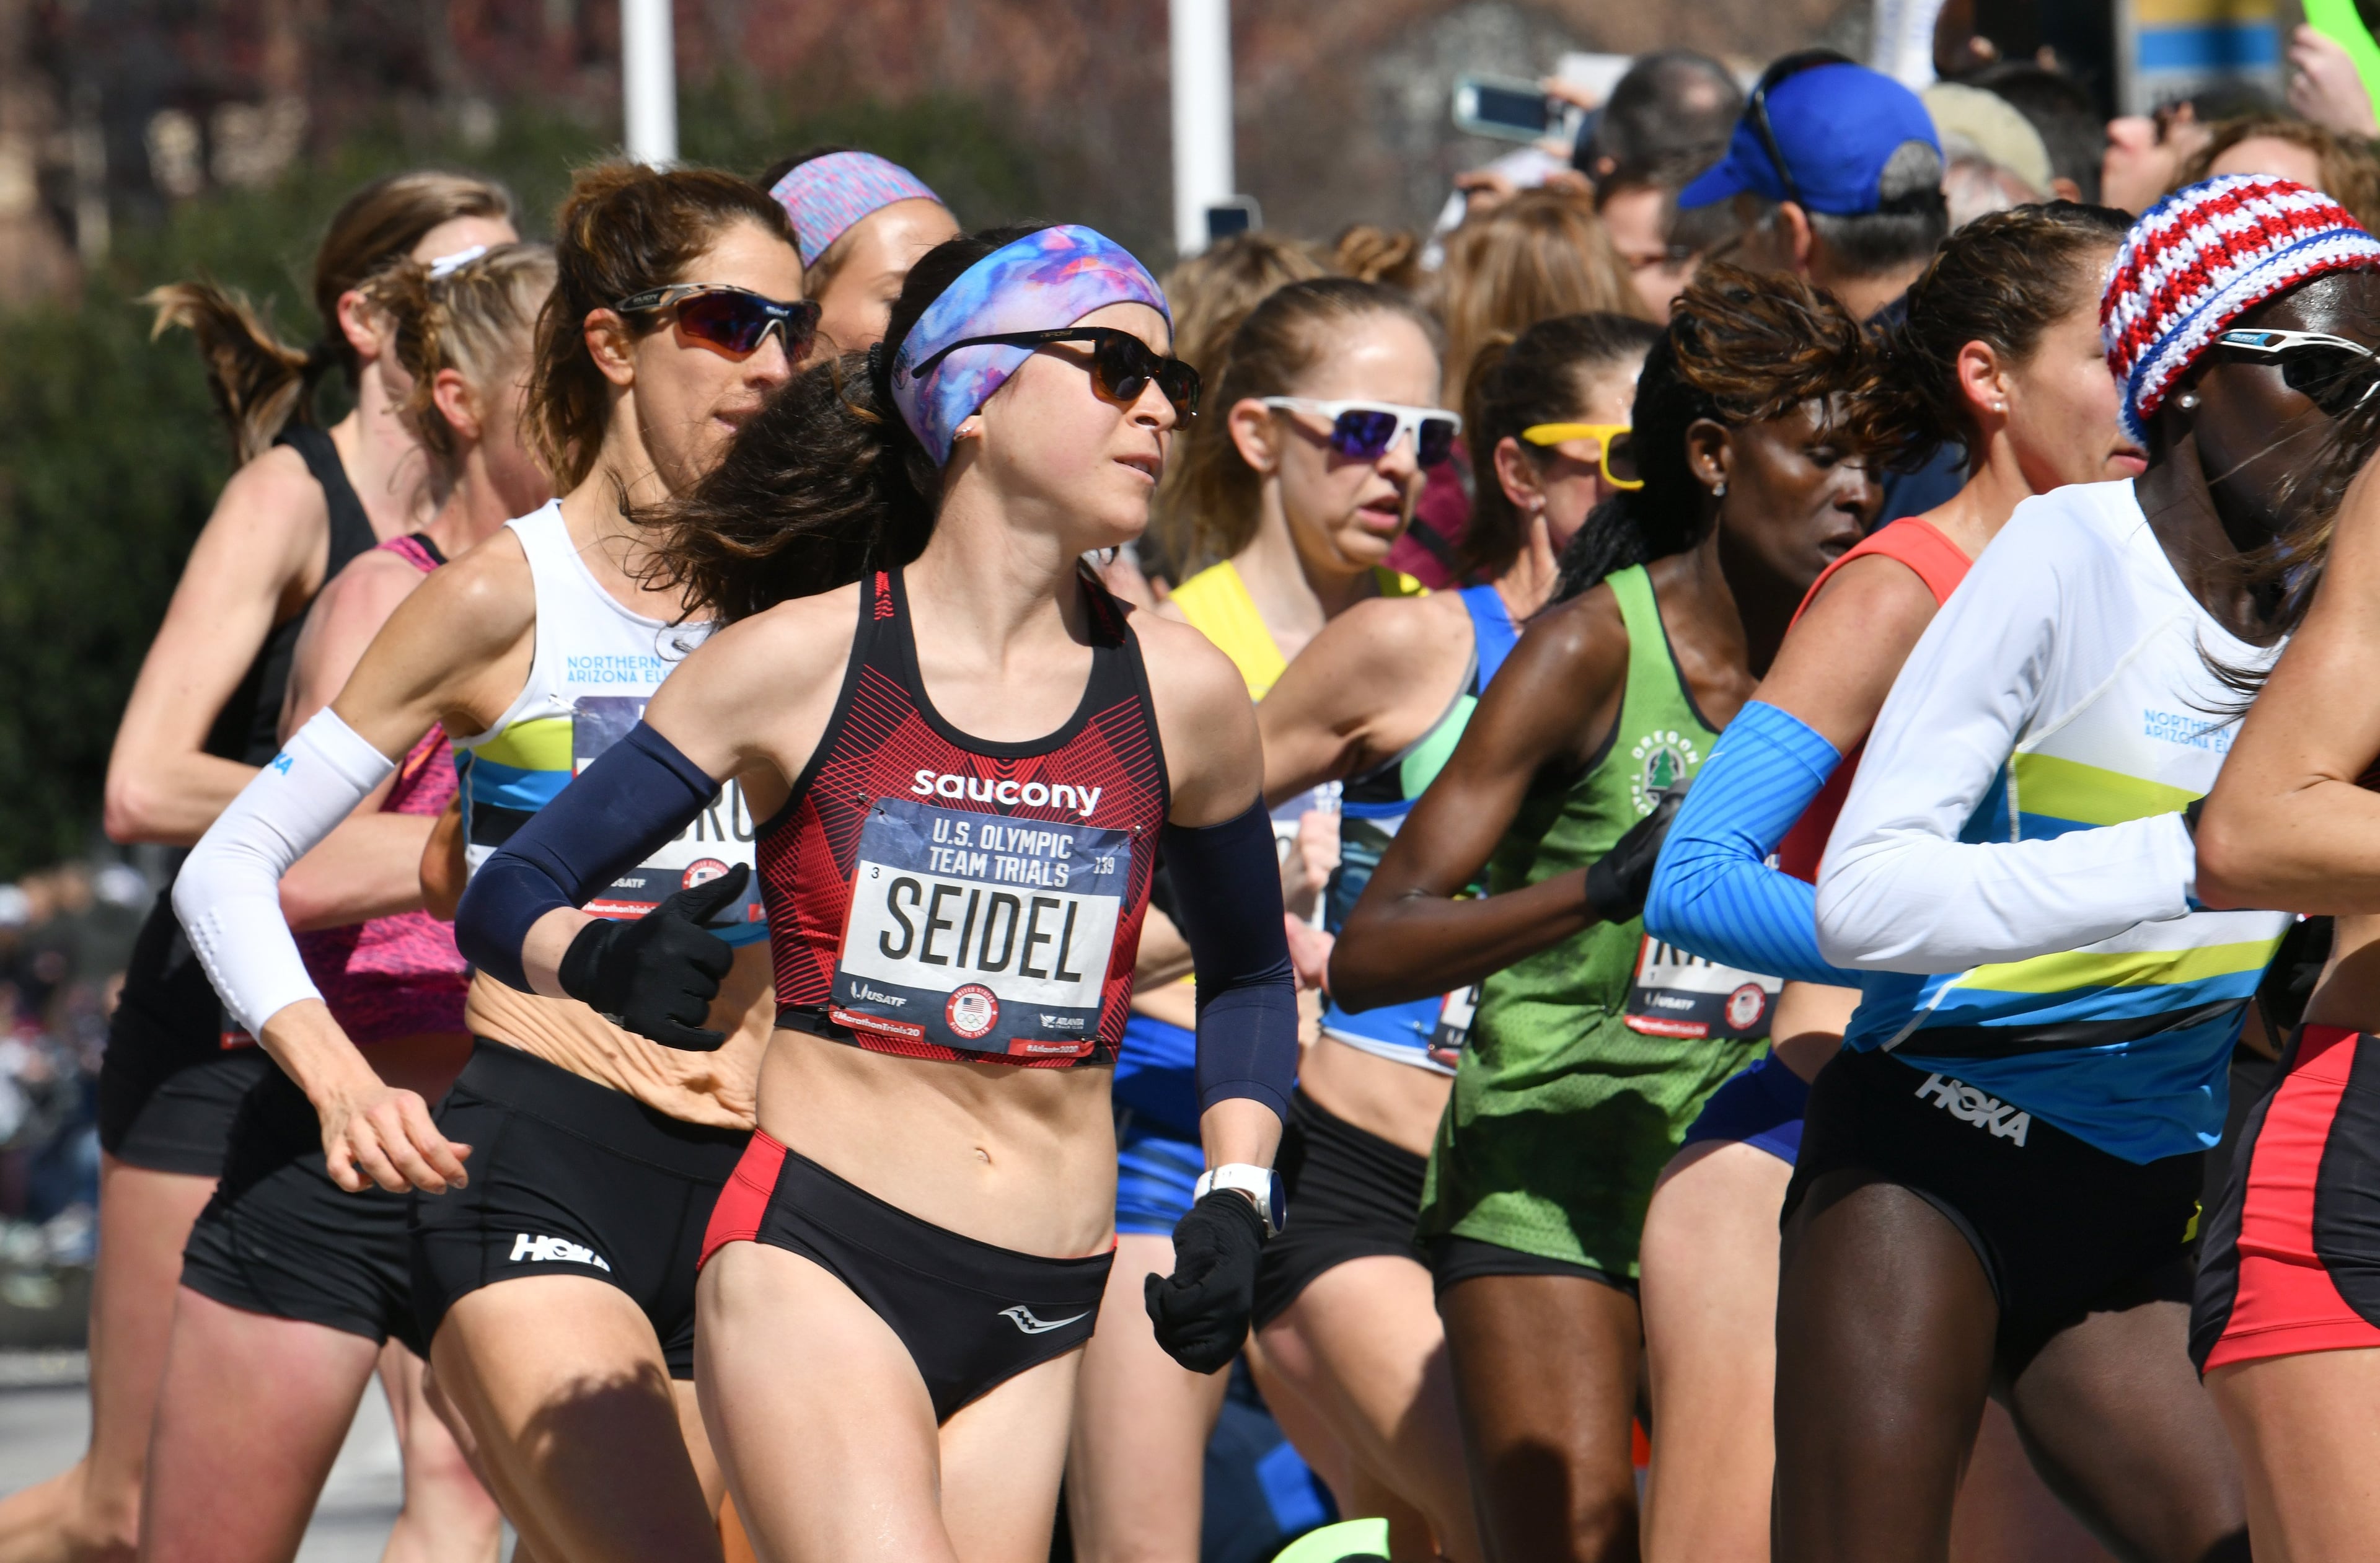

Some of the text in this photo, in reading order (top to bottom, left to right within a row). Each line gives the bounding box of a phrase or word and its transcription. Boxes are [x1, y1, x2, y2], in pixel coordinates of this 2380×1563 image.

[567, 656, 661, 669] NORTHERN
[567, 669, 671, 683] ARIZONA ELI
[1631, 729, 1699, 765] OREGON
[910, 768, 1102, 817] saucony
[933, 817, 1073, 860] U.S. OLYMPIC
[870, 866, 879, 879] 3
[929, 845, 1070, 889] TEAM TRIALS
[1093, 856, 1115, 874] 139
[878, 876, 1082, 983] SEIDEL
[866, 990, 907, 1007] USATF
[953, 987, 995, 1003] UNITED STATES
[832, 1010, 920, 1037] #MarathonTrials20
[949, 1021, 990, 1037] OLYMPIC TEAM
[1914, 1073, 2032, 1148] HOKA
